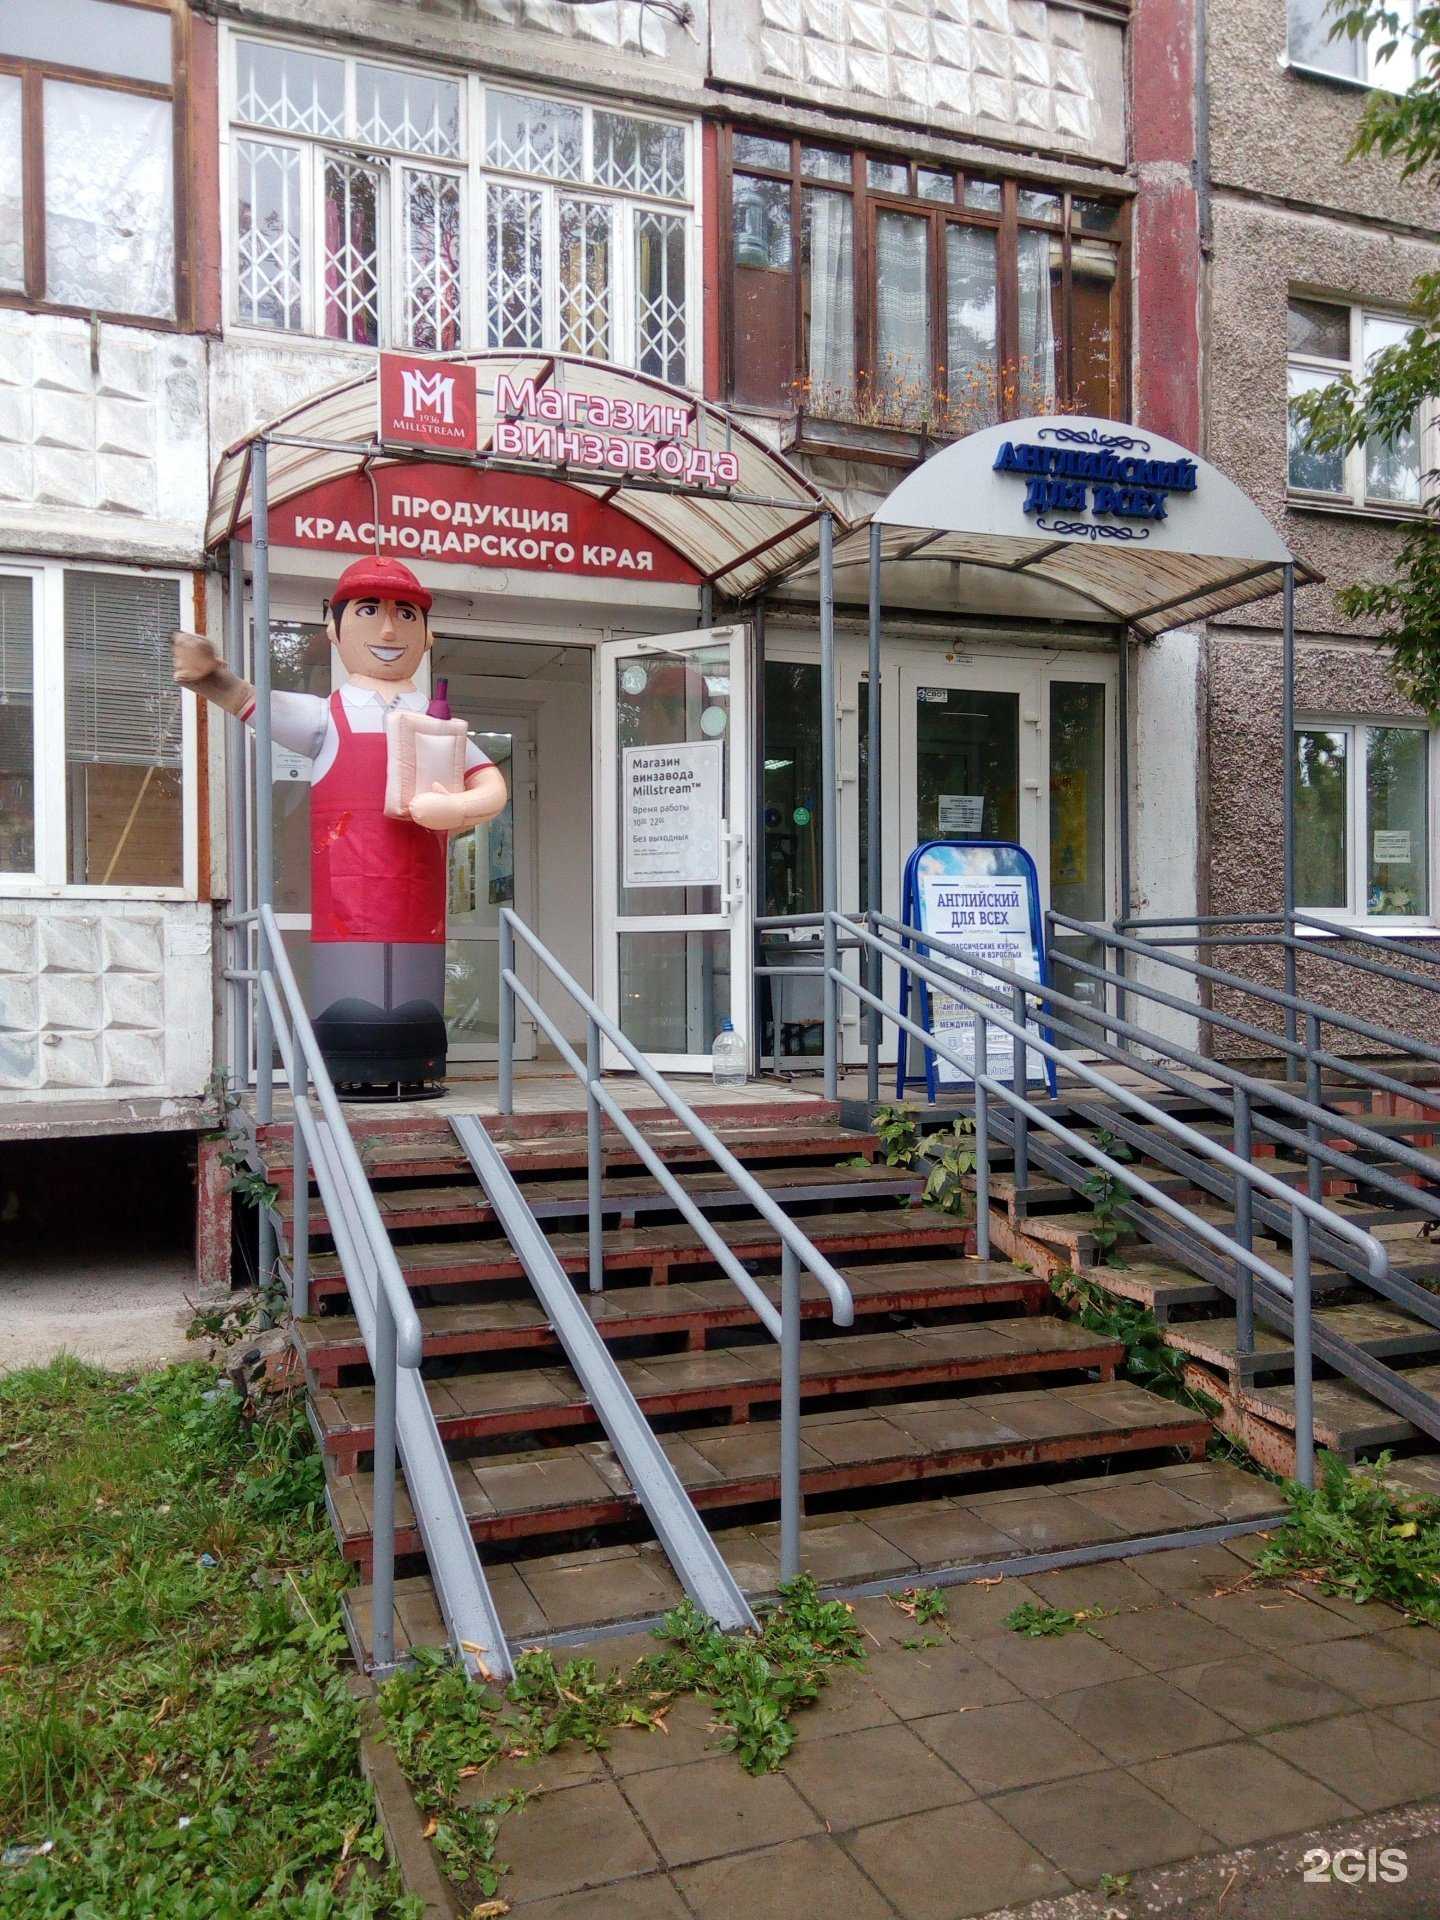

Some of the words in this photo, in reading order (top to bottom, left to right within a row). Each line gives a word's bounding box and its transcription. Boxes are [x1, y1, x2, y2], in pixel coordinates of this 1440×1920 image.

[497, 374, 688, 437] Магазин
[393, 419, 465, 438] MILLSTREAM
[420, 414, 440, 425] 1936
[496, 422, 740, 488] винзавода
[391, 494, 569, 534] ПРОДУКЦИЯ
[294, 515, 576, 564] КРАСНОДАРСКОГО
[582, 544, 653, 571] КРАЯ
[632, 758, 681, 769] Магазин
[632, 771, 694, 783] винзавода
[937, 891, 1020, 907] АНГЛИЙСКИЙ
[951, 911, 976, 928] ДЛЯ
[978, 911, 1009, 925] ВСЕХ
